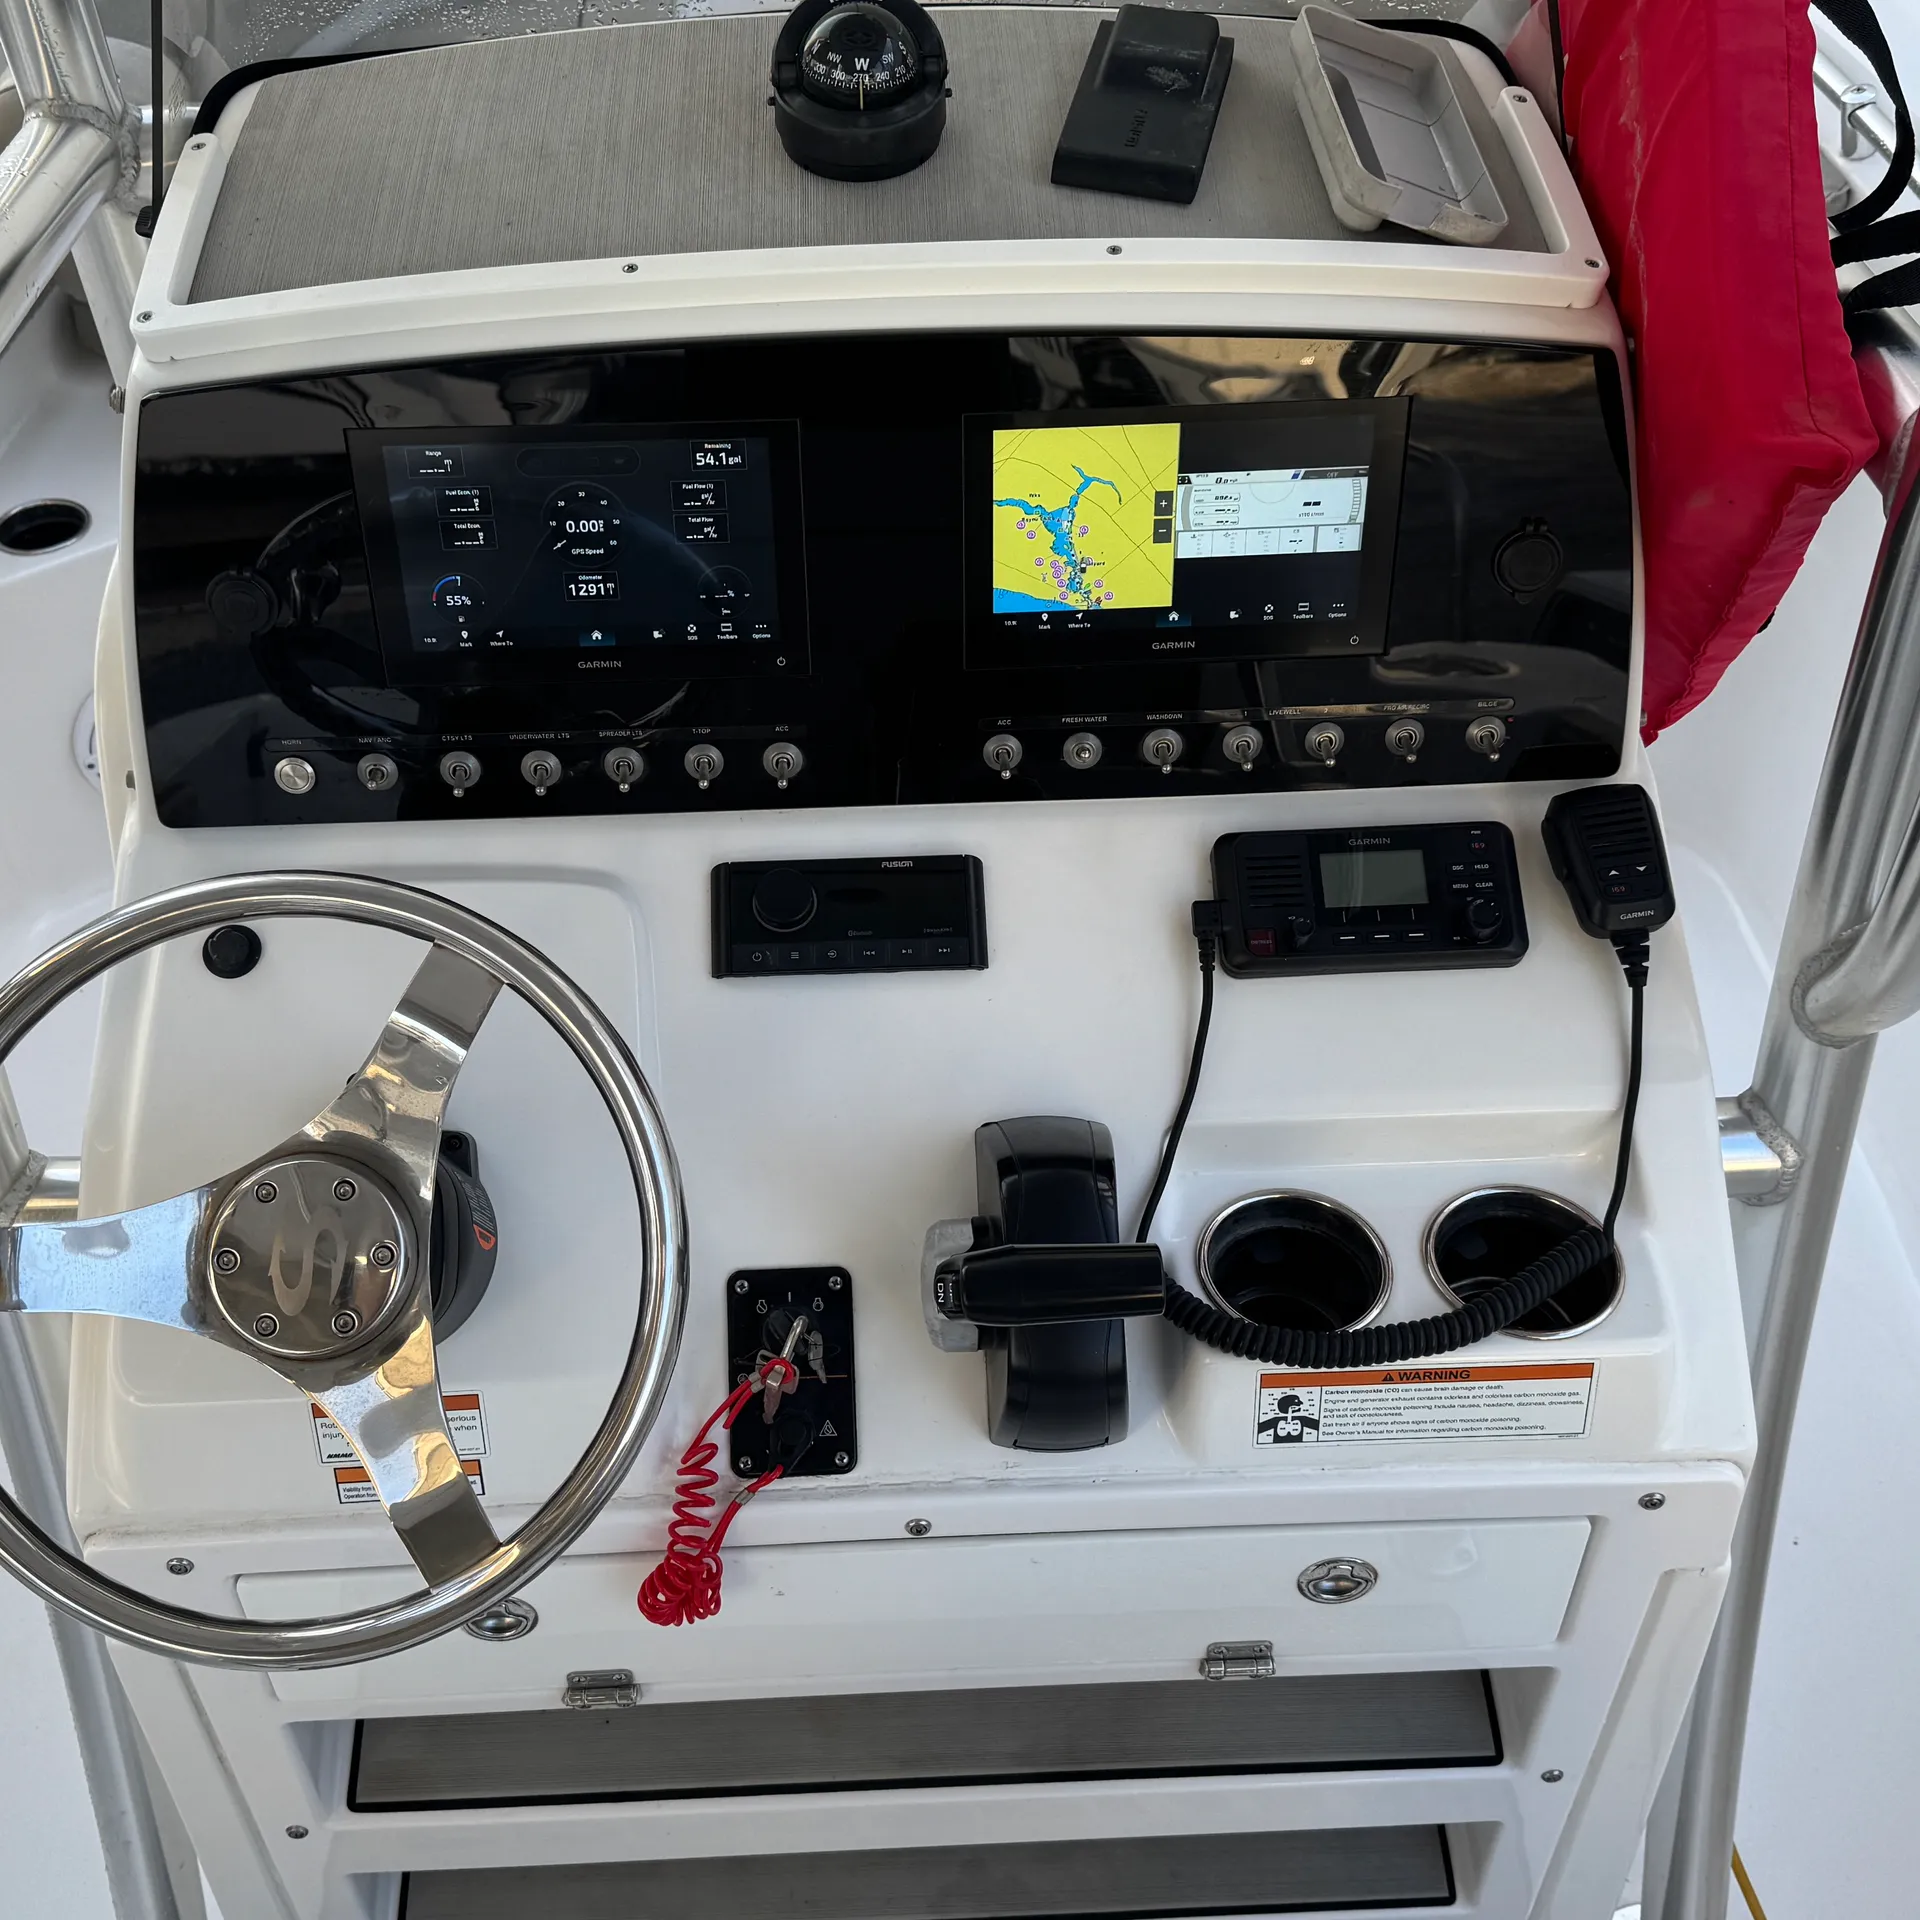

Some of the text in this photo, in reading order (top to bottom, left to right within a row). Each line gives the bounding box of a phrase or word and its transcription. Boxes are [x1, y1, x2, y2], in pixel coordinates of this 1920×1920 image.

[827, 52, 842, 63] NW
[882, 52, 894, 64] SW
[855, 58, 869, 70] W
[831, 70, 845, 80] 300
[875, 71, 890, 81] 240
[895, 65, 906, 77] 210
[853, 73, 868, 82] 270
[696, 452, 727, 466] 54.1
[566, 520, 599, 533] 0.00
[569, 583, 605, 596] 1291
[446, 595, 472, 606] 55%
[1152, 641, 1196, 650] GARMIN
[577, 660, 622, 669] GARMIN
[1348, 837, 1391, 846] GARMIN
[881, 860, 913, 868] FUSION
[1620, 910, 1655, 920] GARMIN
[937, 1282, 945, 1303] DN
[1398, 1370, 1471, 1381] WARNING
